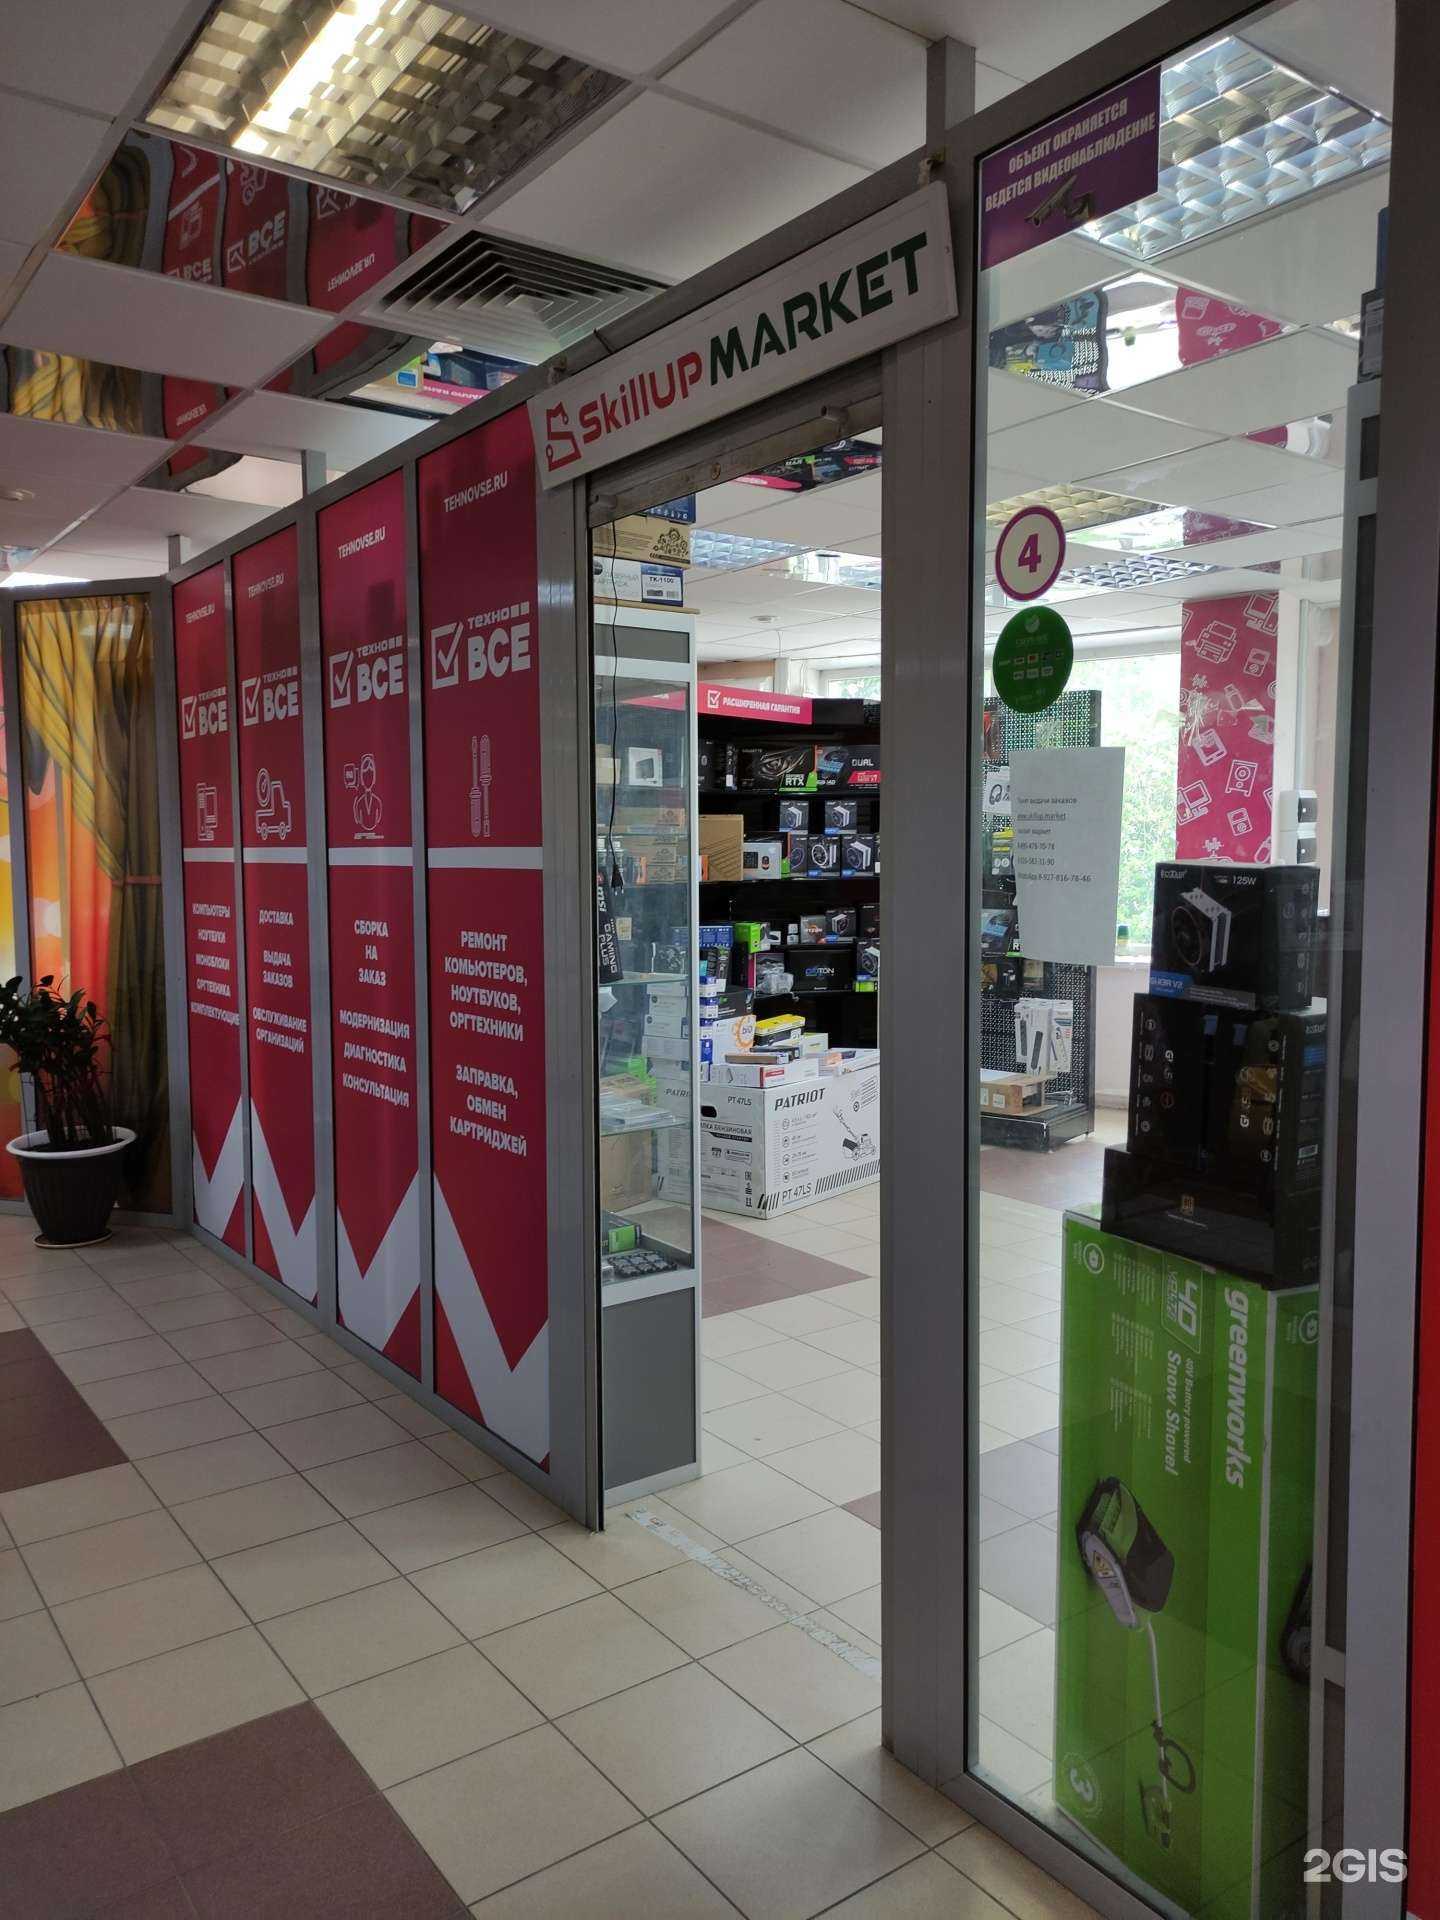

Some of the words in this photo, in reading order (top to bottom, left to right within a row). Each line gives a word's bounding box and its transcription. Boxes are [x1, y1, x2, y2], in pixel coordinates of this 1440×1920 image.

[1009, 135, 1051, 174] ОБЪЕКТ
[1053, 96, 1128, 149] ОХРАНЯЕТСЯ
[985, 176, 1032, 212] ВЕДЕТСЯ
[1033, 111, 1156, 190] ВИДЕОНАБЛЮДЕНИЕ
[444, 471, 509, 513] TEHNOVSE.RU
[338, 526, 386, 560] TEHNOVSE.RU
[1018, 533, 1042, 574] 4
[248, 572, 285, 599] TEHNOVSE.RU
[467, 622, 531, 682] ВСЕ
[356, 653, 404, 703] ВСЕ
[263, 681, 299, 723] ВСЕ
[722, 696, 770, 711] РАСШИРЕННАЯ
[770, 703, 801, 715] ГАРАНТИЯ
[199, 700, 228, 736] ВСЕ
[851, 758, 874, 767] DUAL
[785, 777, 805, 787] RTX
[1232, 875, 1257, 886] 125W
[258, 909, 294, 926] ДОСТАВКА
[354, 919, 389, 938] СБОРКА
[365, 944, 378, 961] НА
[460, 931, 508, 952] РЕМОНТ
[263, 949, 292, 967] ВЫДАЧА
[444, 956, 528, 986] КОМЬЮТЕРОВ,
[196, 978, 231, 998] ОРГТЕХНИКА
[262, 970, 294, 988] ЗАКАЗОВ
[358, 967, 387, 987] ЗАКАЗ
[450, 983, 522, 1015] НОУТБУКОВ,
[252, 1006, 307, 1033] ОБСЛУЖИВАНИЕ
[339, 1008, 410, 1040] МОДЕРНИЗАЦИЯ
[449, 1011, 524, 1042] ОРГТЕХНИКИ
[255, 1028, 304, 1054] ОРГАНИЗАЦИЙ
[343, 1041, 407, 1073] ДИАГНОСТИКА
[342, 1072, 410, 1108] КОНСУЛЬТАЦИЯ
[455, 1064, 519, 1100] ЗАПРАВКА,
[466, 1094, 507, 1122] ОБМЕН
[727, 1095, 737, 1104] PT
[774, 1088, 826, 1111] PATRIOT
[449, 1116, 527, 1157] КАРТРИДЖЕЙ
[782, 1189, 792, 1202] PT
[1166, 1350, 1181, 1404] Snow
[1224, 1287, 1252, 1489] greenworks
[1182, 1379, 1194, 1415] Battery
